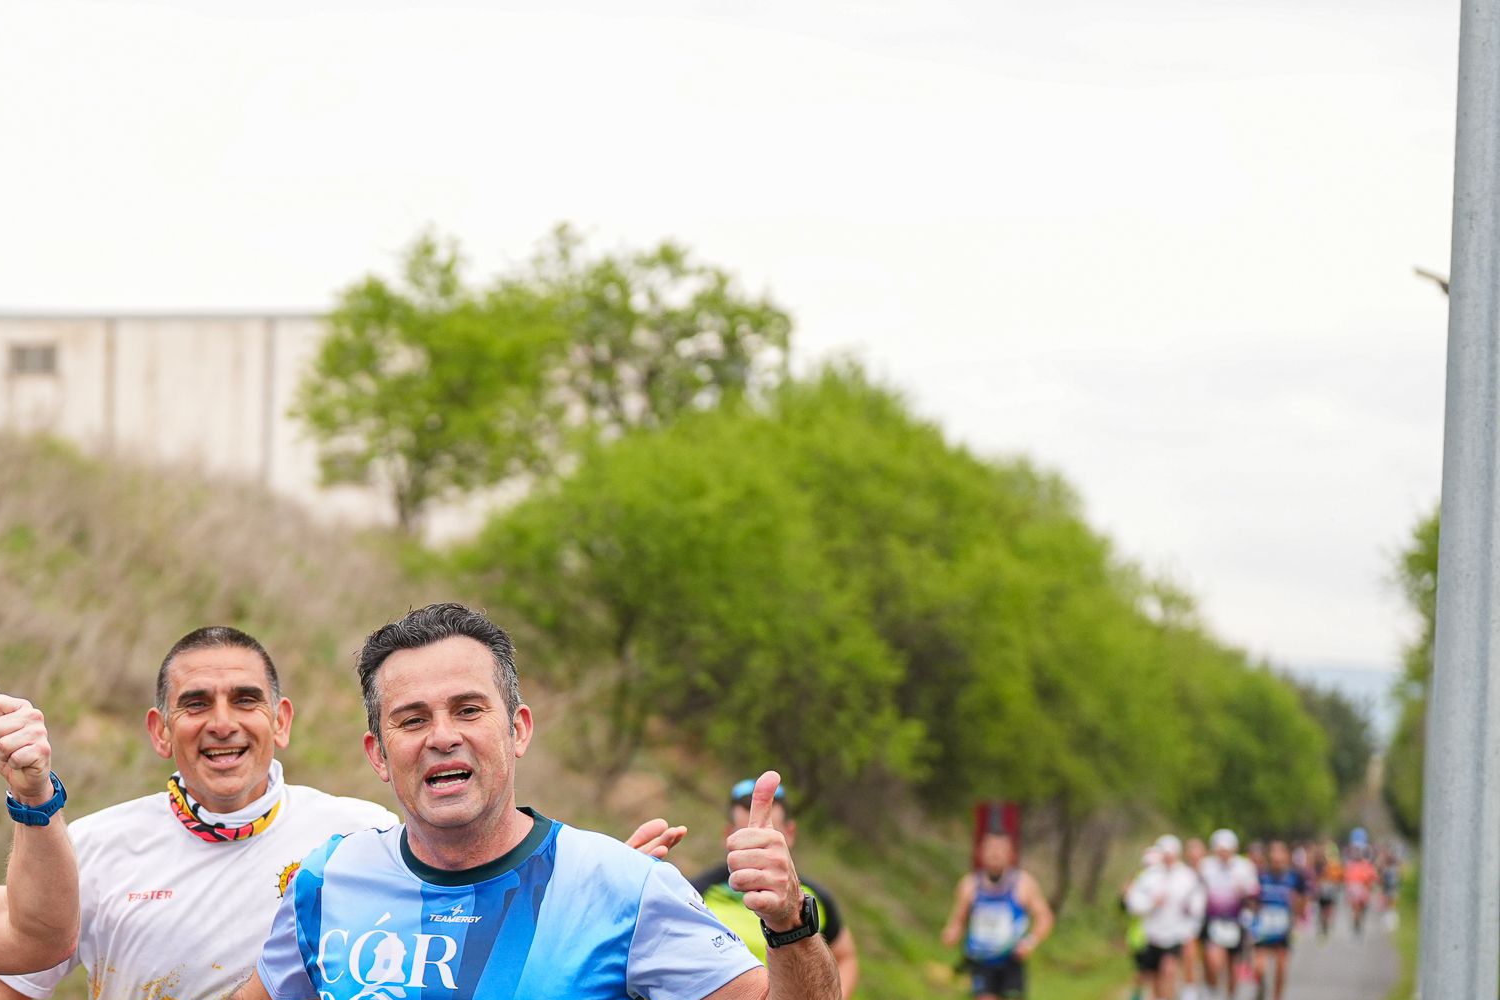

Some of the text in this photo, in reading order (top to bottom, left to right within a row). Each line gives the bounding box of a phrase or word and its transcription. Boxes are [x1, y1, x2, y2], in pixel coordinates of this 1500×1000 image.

[128, 890, 173, 902] FASTER
[429, 914, 483, 924] TEAMERGY
[317, 912, 459, 989] CÓR
